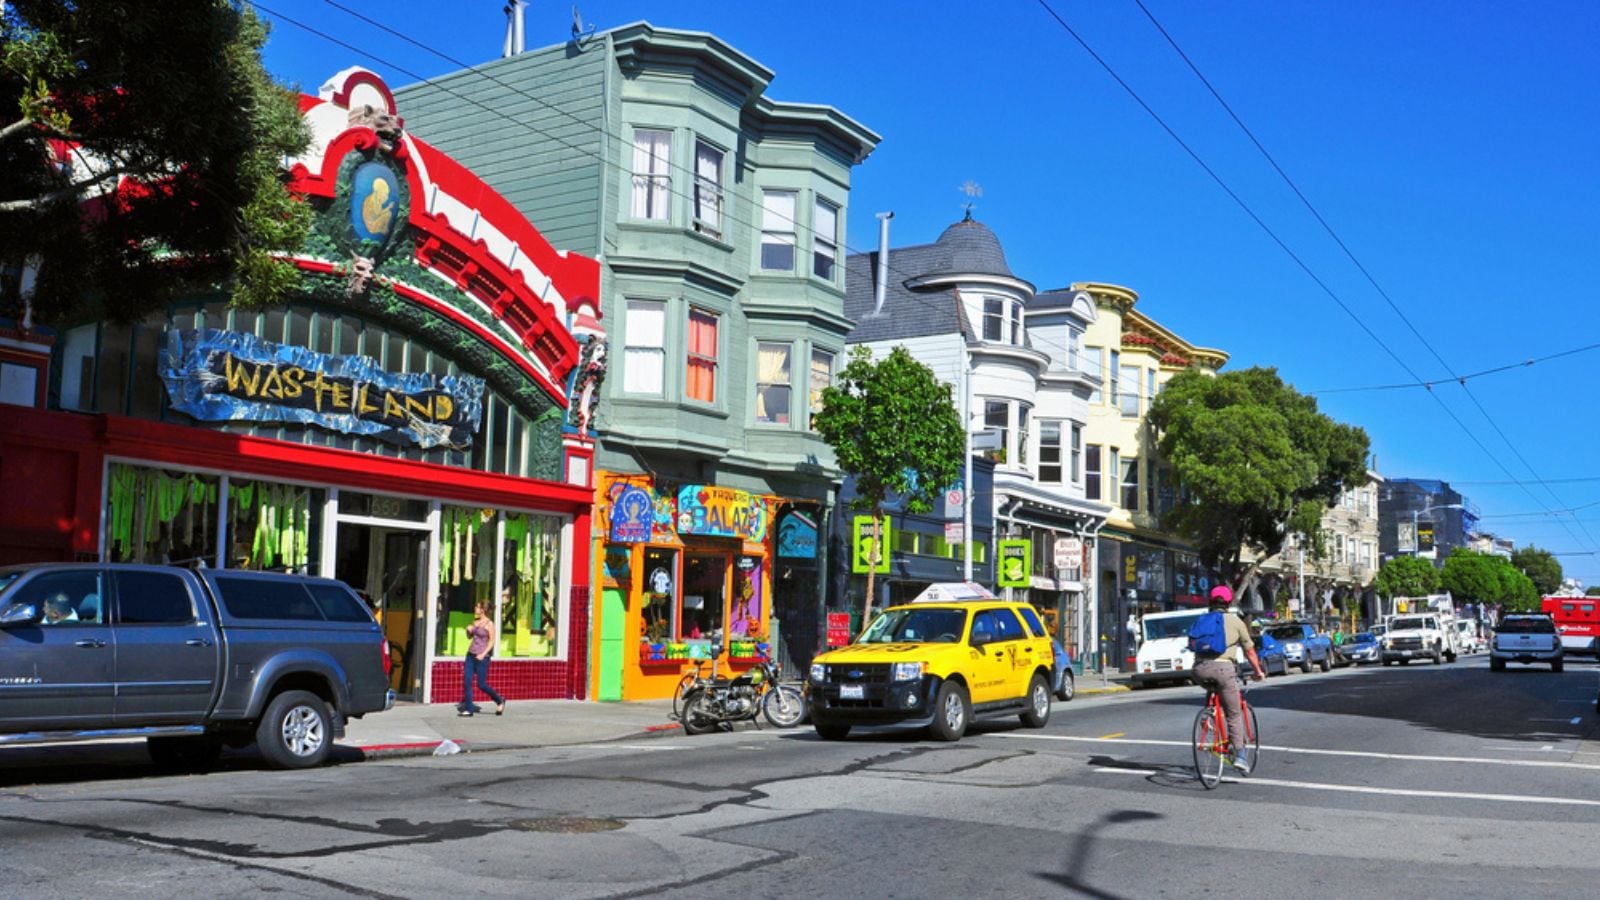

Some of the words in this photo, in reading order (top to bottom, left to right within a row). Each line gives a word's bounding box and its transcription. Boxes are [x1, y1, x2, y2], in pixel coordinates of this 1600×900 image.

[225, 351, 454, 421] WASTELAND
[860, 525, 884, 536] BOOS
[1004, 547, 1025, 556] BOOKS
